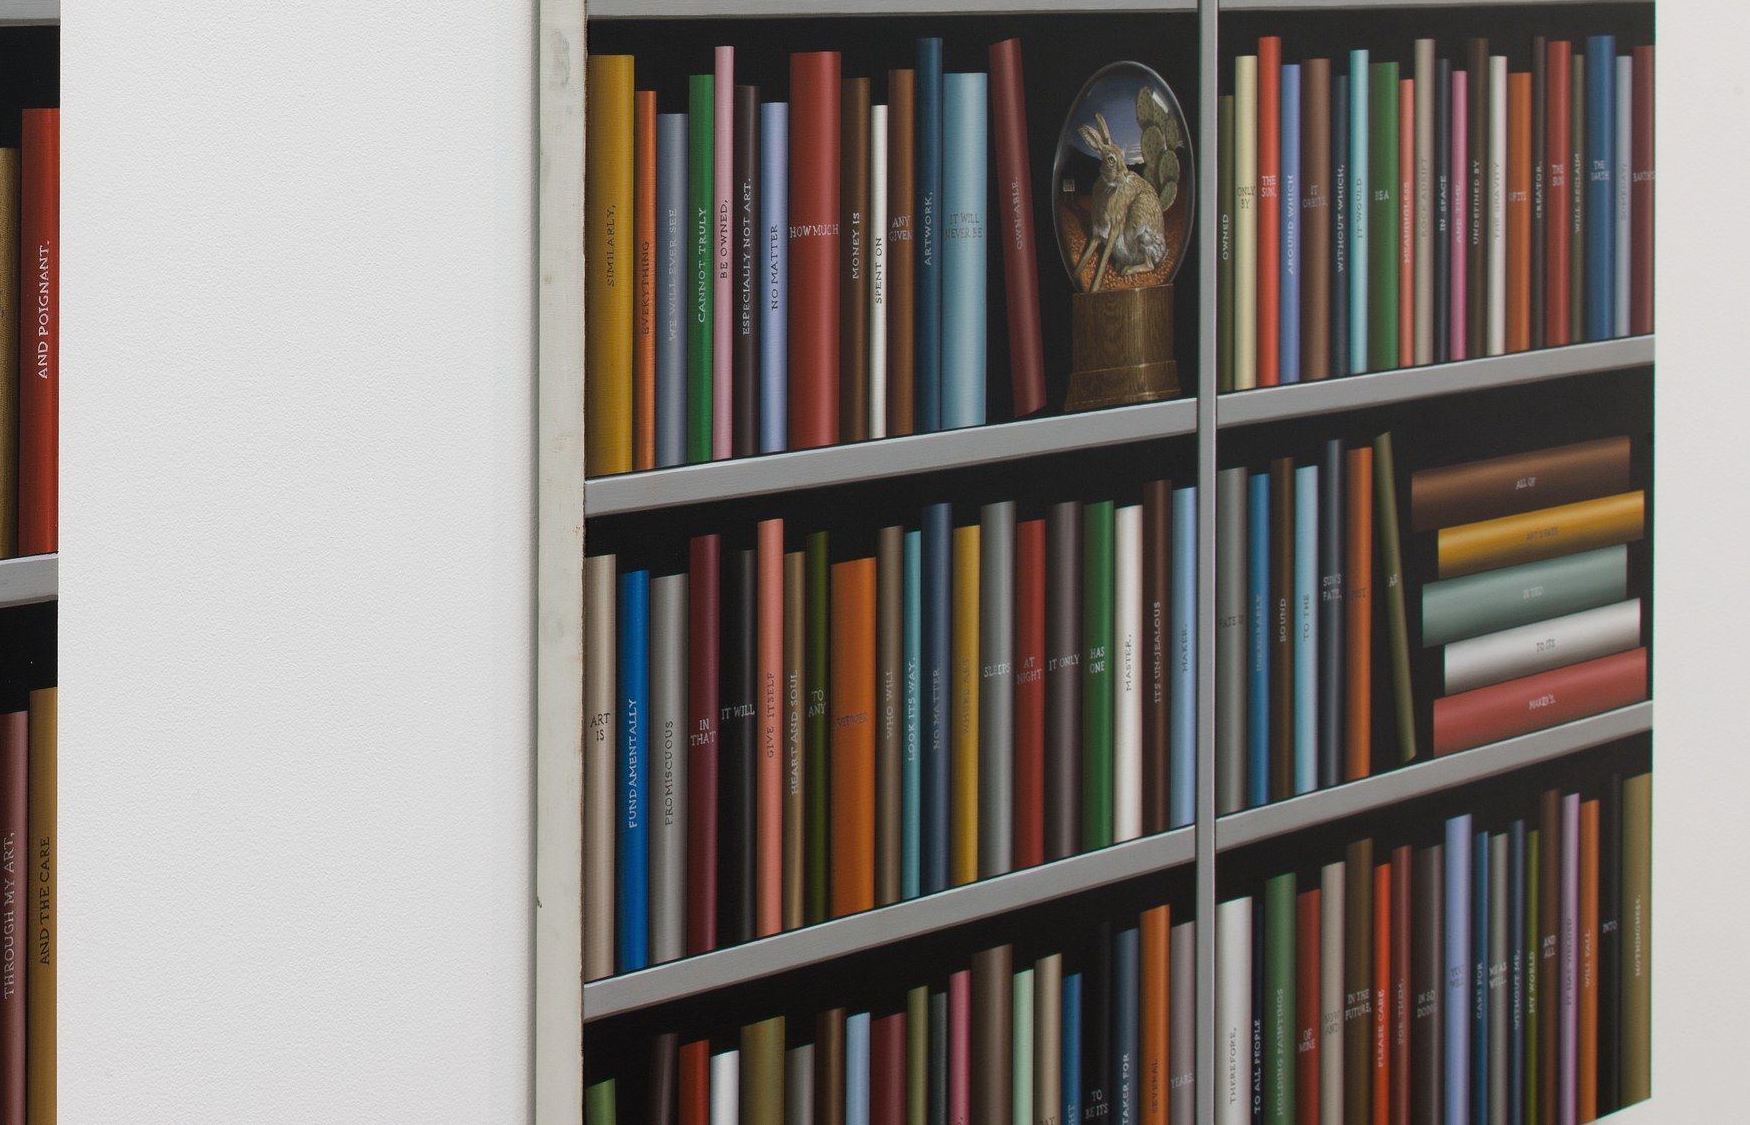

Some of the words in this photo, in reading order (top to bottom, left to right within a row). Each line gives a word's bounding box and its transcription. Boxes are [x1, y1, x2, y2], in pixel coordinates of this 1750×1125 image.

[1337, 164, 1345, 210] WHICH,
[699, 207, 707, 256] TRULY
[720, 199, 728, 256] OWNED,
[790, 226, 812, 238] HOW
[813, 224, 839, 236] MUCH
[852, 212, 860, 225] IS
[924, 192, 932, 266] ARTWORK,
[1012, 177, 1022, 250] OWN-ABLE.
[770, 224, 778, 284] MATTER
[852, 229, 860, 279] MONEY
[875, 237, 881, 257] ON
[1337, 214, 1345, 272] WITHOUT
[698, 260, 707, 323] CANNOT
[720, 261, 728, 279] BE
[771, 289, 778, 311] NO
[1090, 646, 1105, 658] HAS
[1090, 660, 1105, 673] ONE
[699, 719, 709, 731] IN
[722, 708, 731, 720] IT
[734, 704, 754, 717] WILL
[690, 732, 716, 746] THAT
[629, 699, 637, 828] FUNDAMENTALLY
[665, 721, 673, 826] PROMISCUOUS
